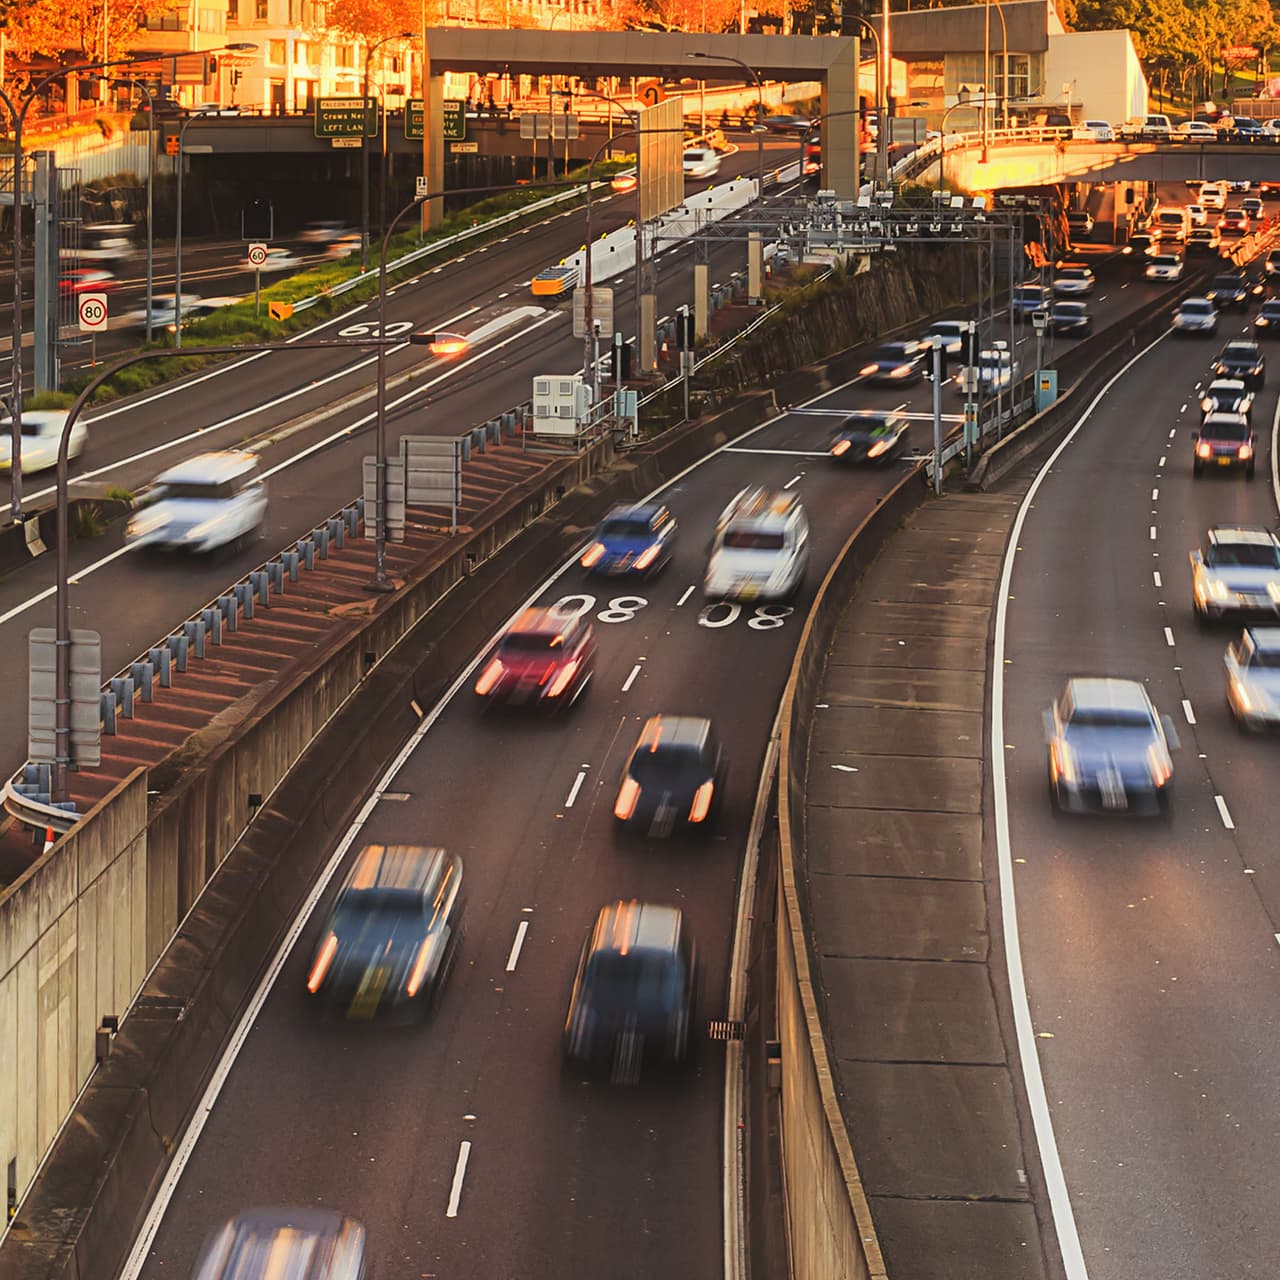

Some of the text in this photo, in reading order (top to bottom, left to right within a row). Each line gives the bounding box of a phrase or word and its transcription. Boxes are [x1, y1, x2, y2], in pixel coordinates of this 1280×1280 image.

[252, 251, 264, 260] 60
[84, 306, 102, 318] 80
[338, 321, 414, 337] 60
[547, 594, 649, 623] 80
[698, 602, 795, 630] 80
